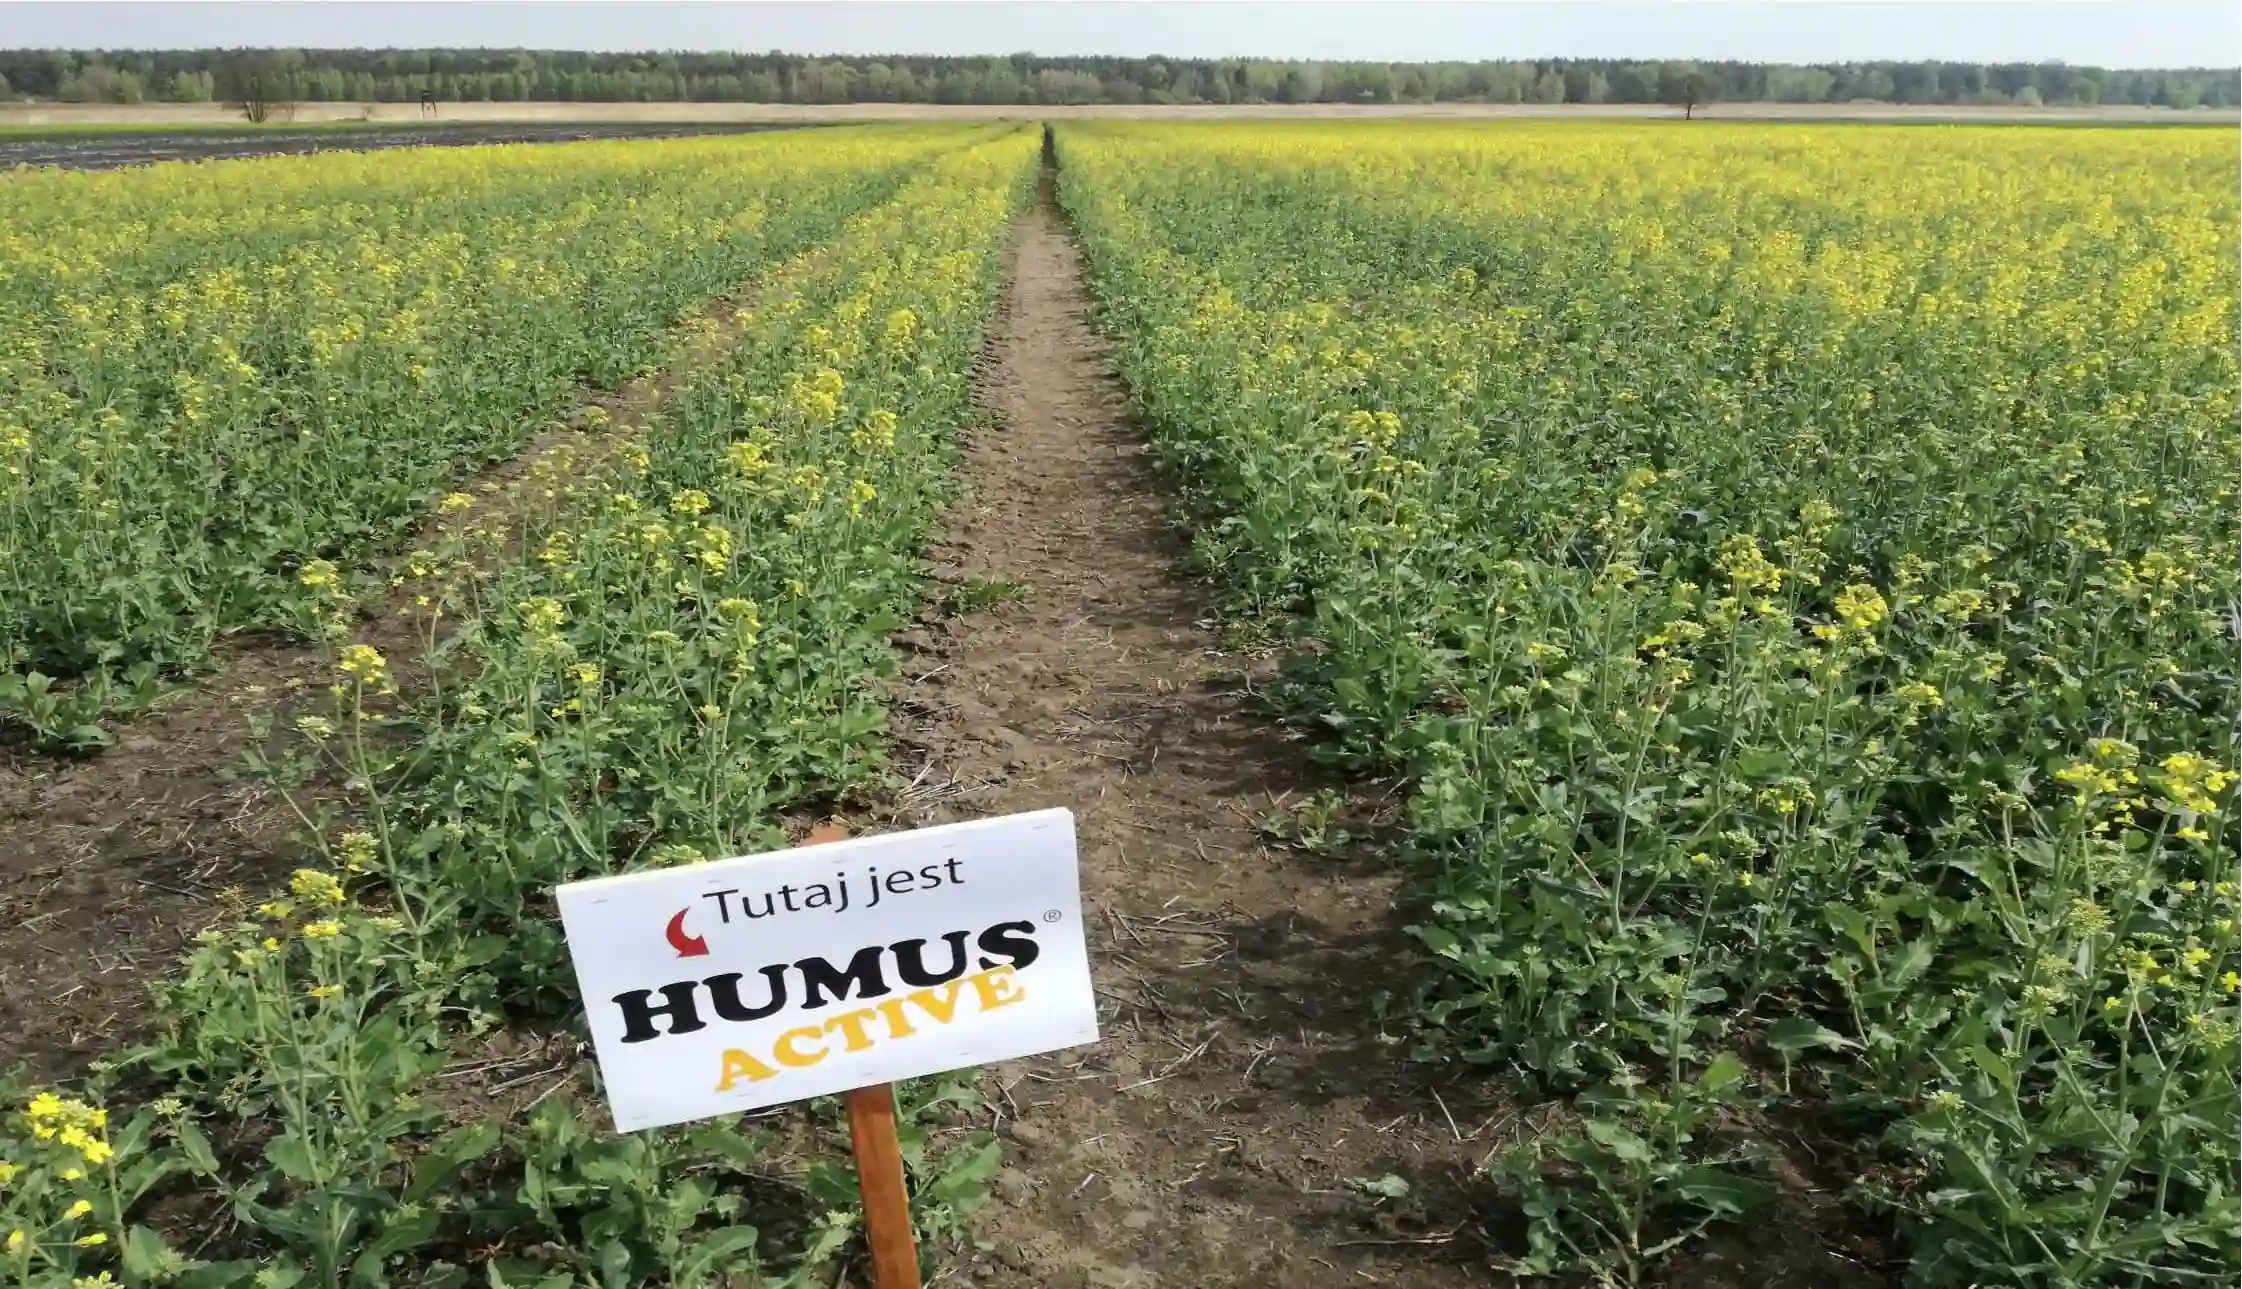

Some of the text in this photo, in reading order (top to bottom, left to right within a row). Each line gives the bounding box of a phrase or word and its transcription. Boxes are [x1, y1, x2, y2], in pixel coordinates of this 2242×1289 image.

[703, 857, 966, 925] Tutaj jest
[611, 919, 1041, 1044] HUMUS
[714, 963, 1027, 1092] ACTIVE
